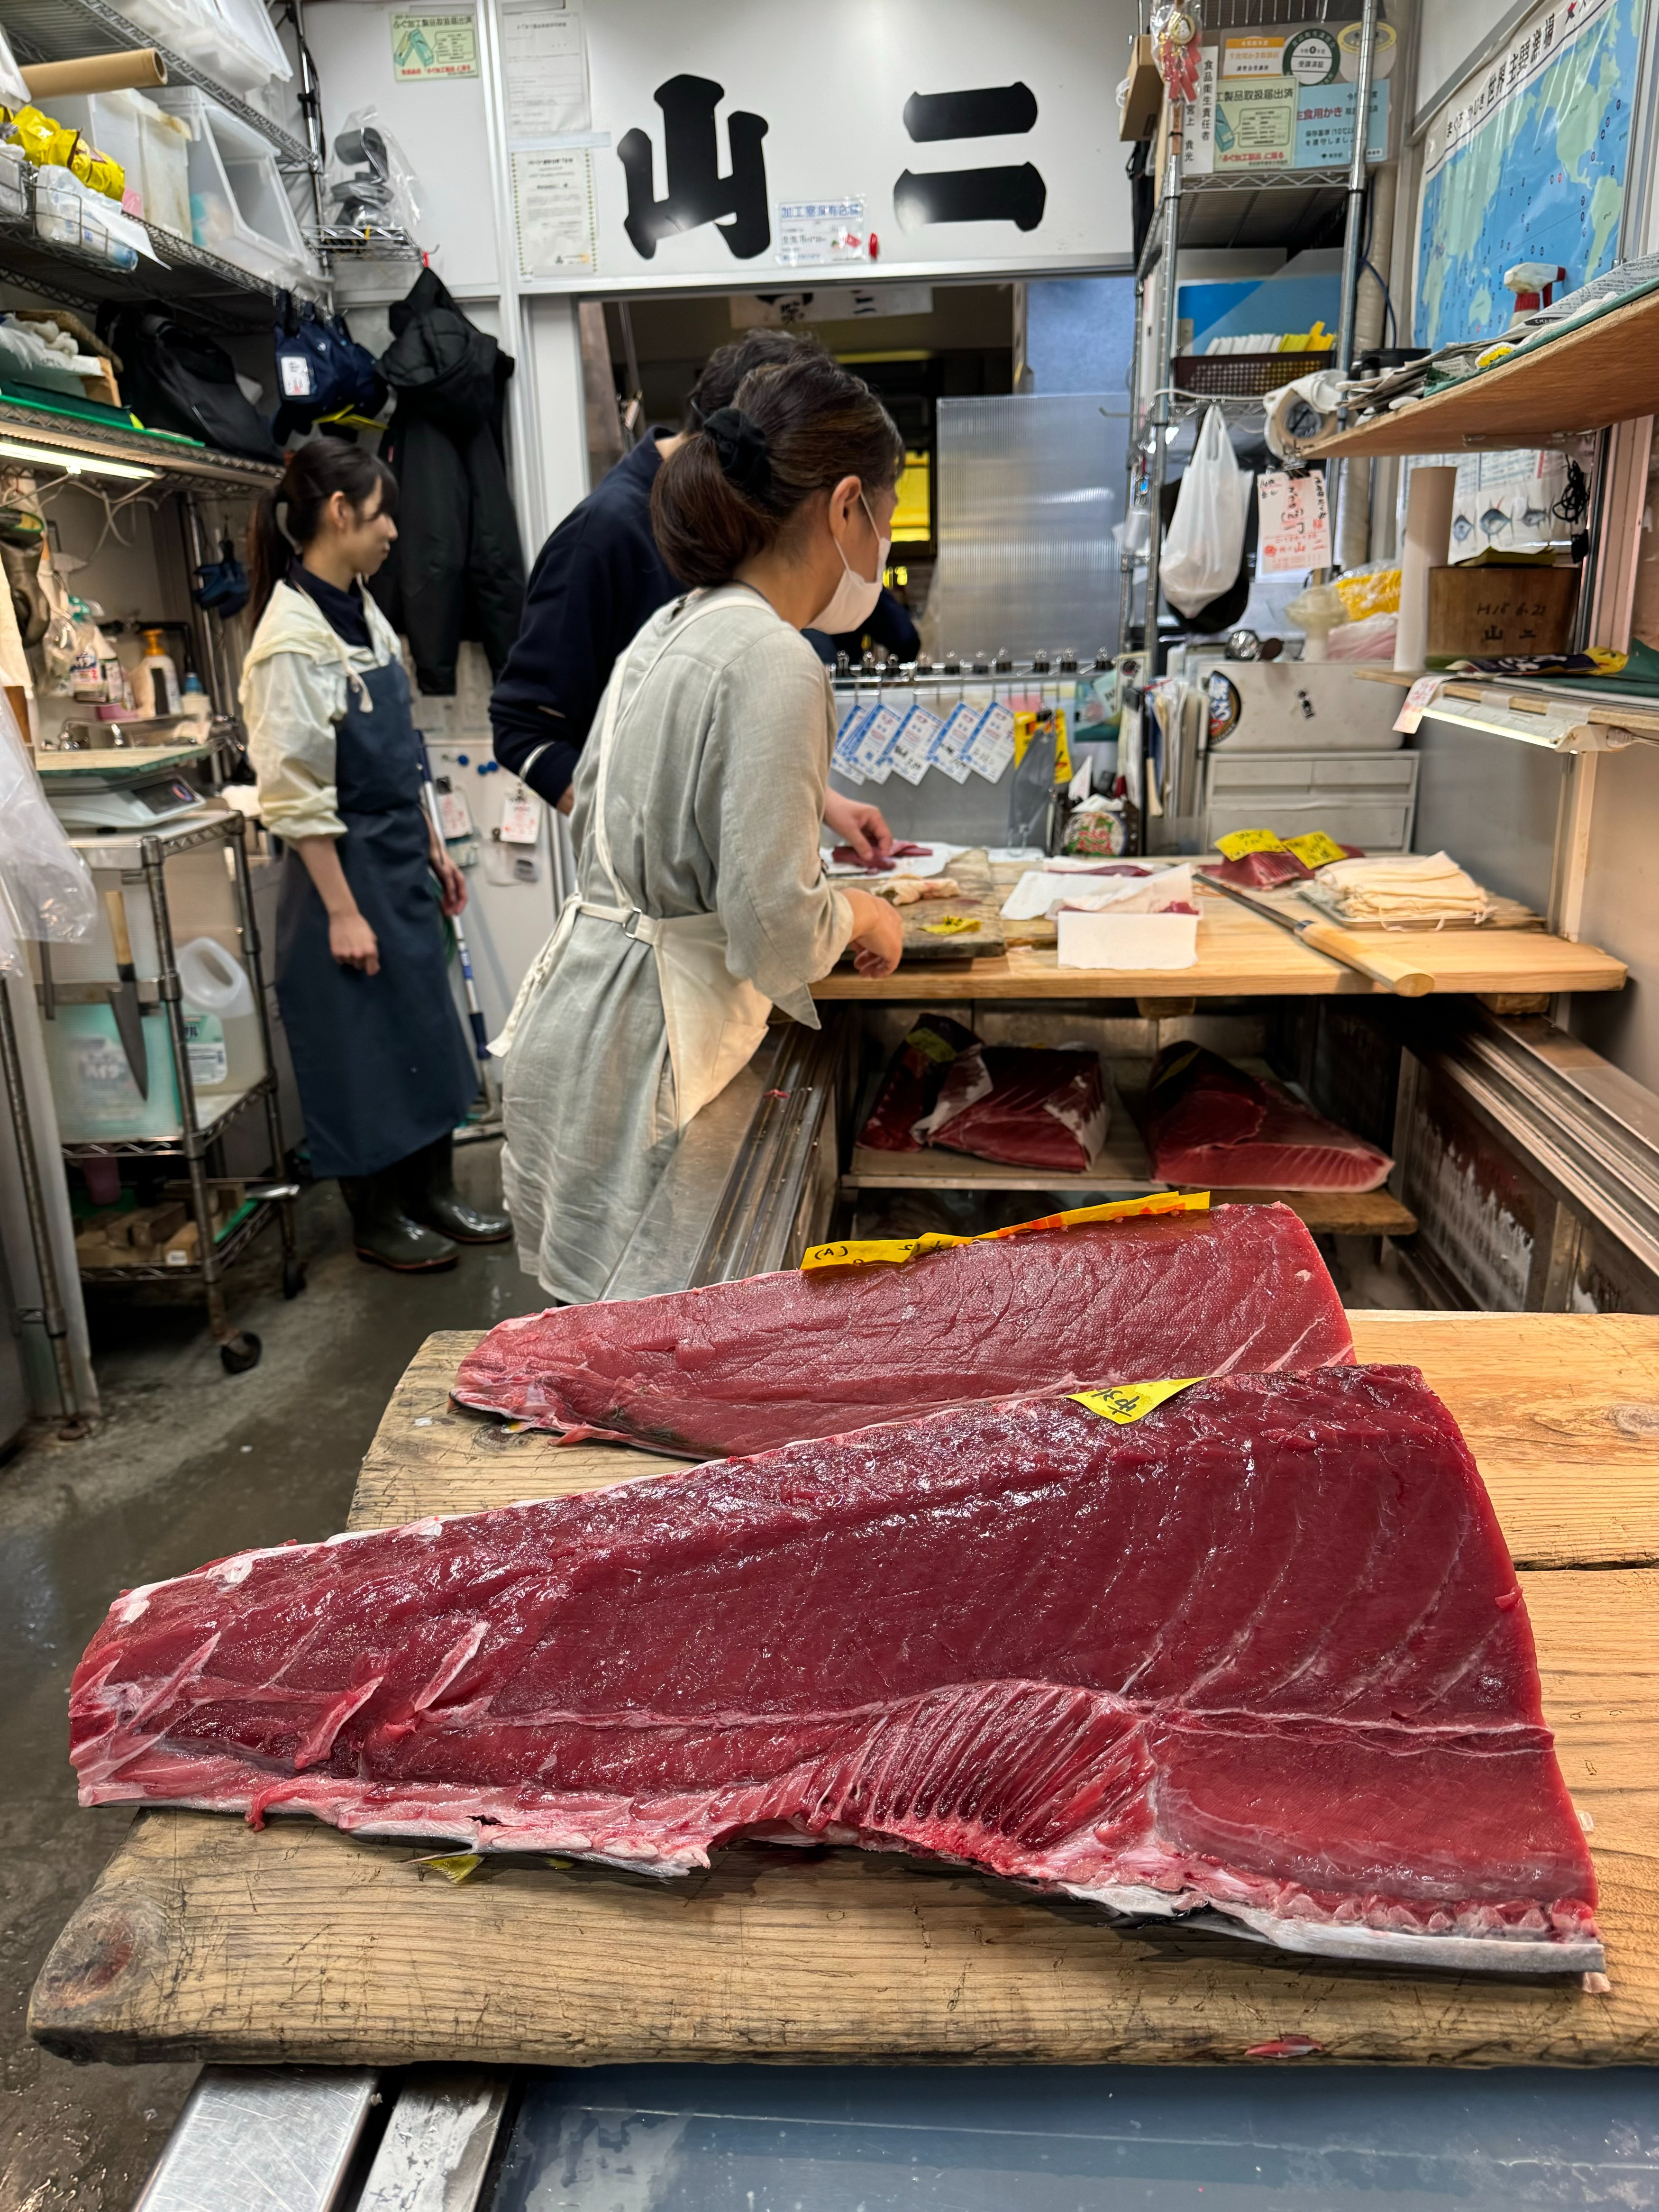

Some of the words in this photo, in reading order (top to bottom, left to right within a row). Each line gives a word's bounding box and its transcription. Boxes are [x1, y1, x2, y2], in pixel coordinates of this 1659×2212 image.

[1202, 60, 1213, 141] 食品衛生責任者
